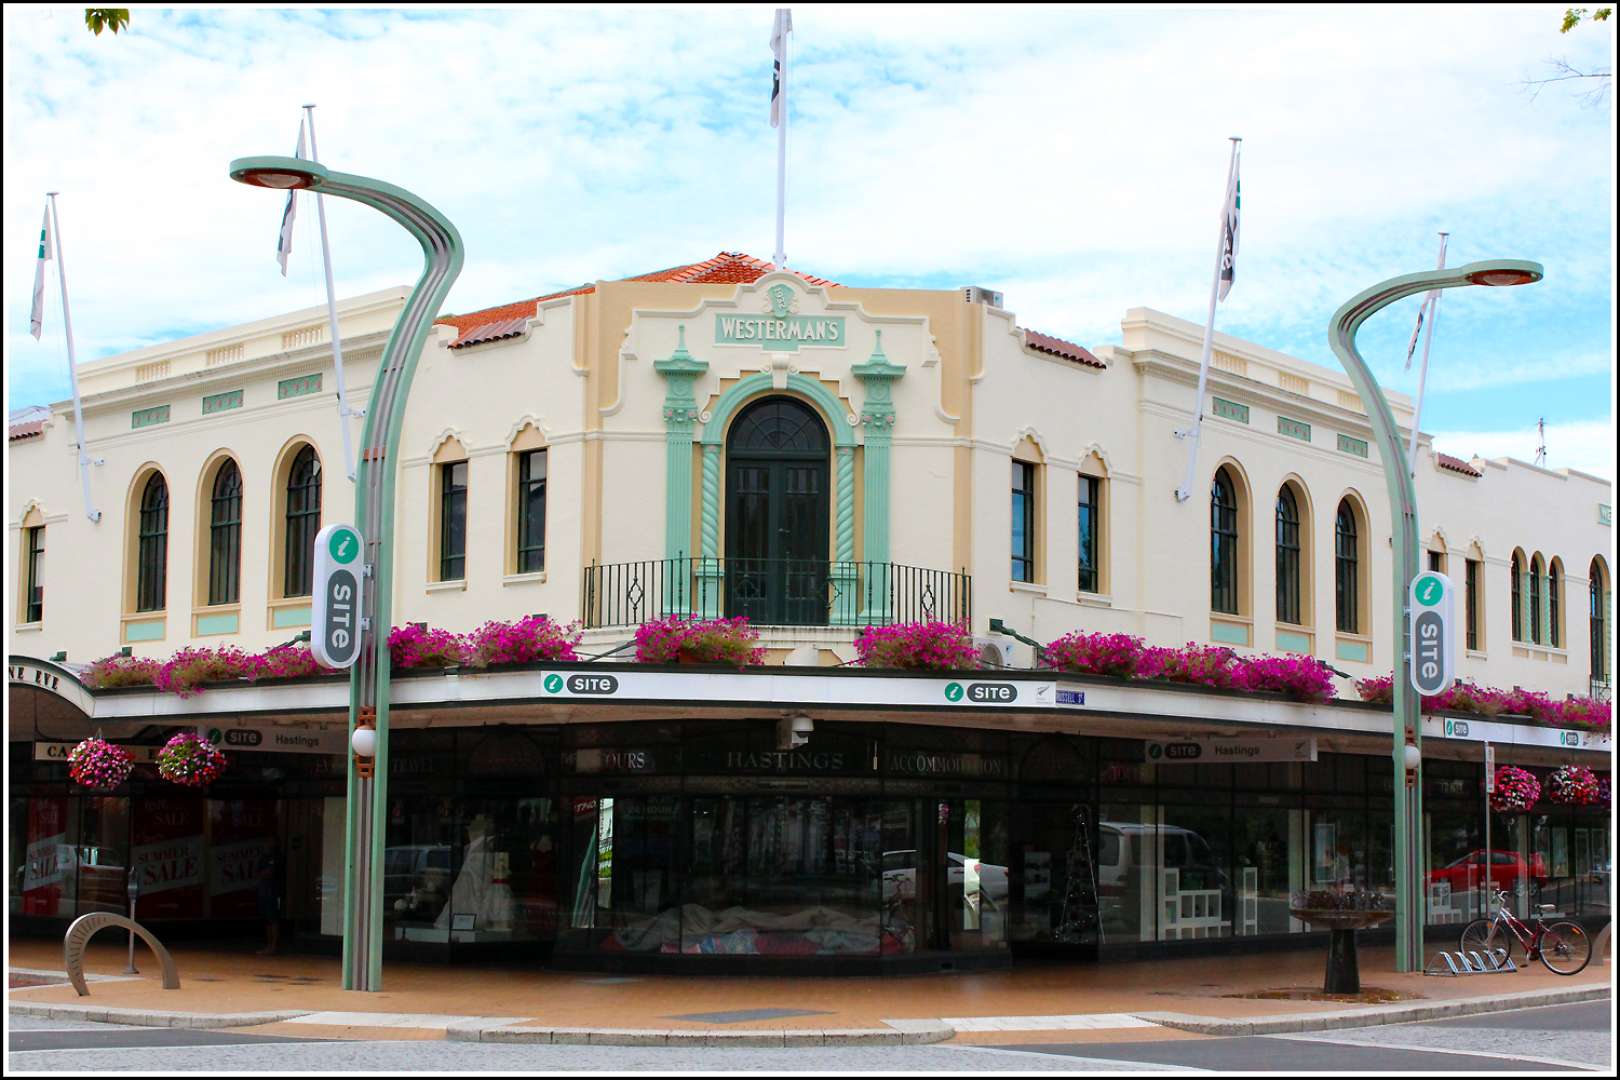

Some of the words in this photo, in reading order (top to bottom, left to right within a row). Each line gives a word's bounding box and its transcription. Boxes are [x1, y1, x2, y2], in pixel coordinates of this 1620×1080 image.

[721, 317, 839, 341] WESTERMAN'S
[276, 733, 320, 749] Hastings
[599, 751, 646, 769] OURS
[1215, 744, 1261, 758] Hastings
[727, 751, 845, 770] HASTINGS
[143, 859, 199, 883] SALE
